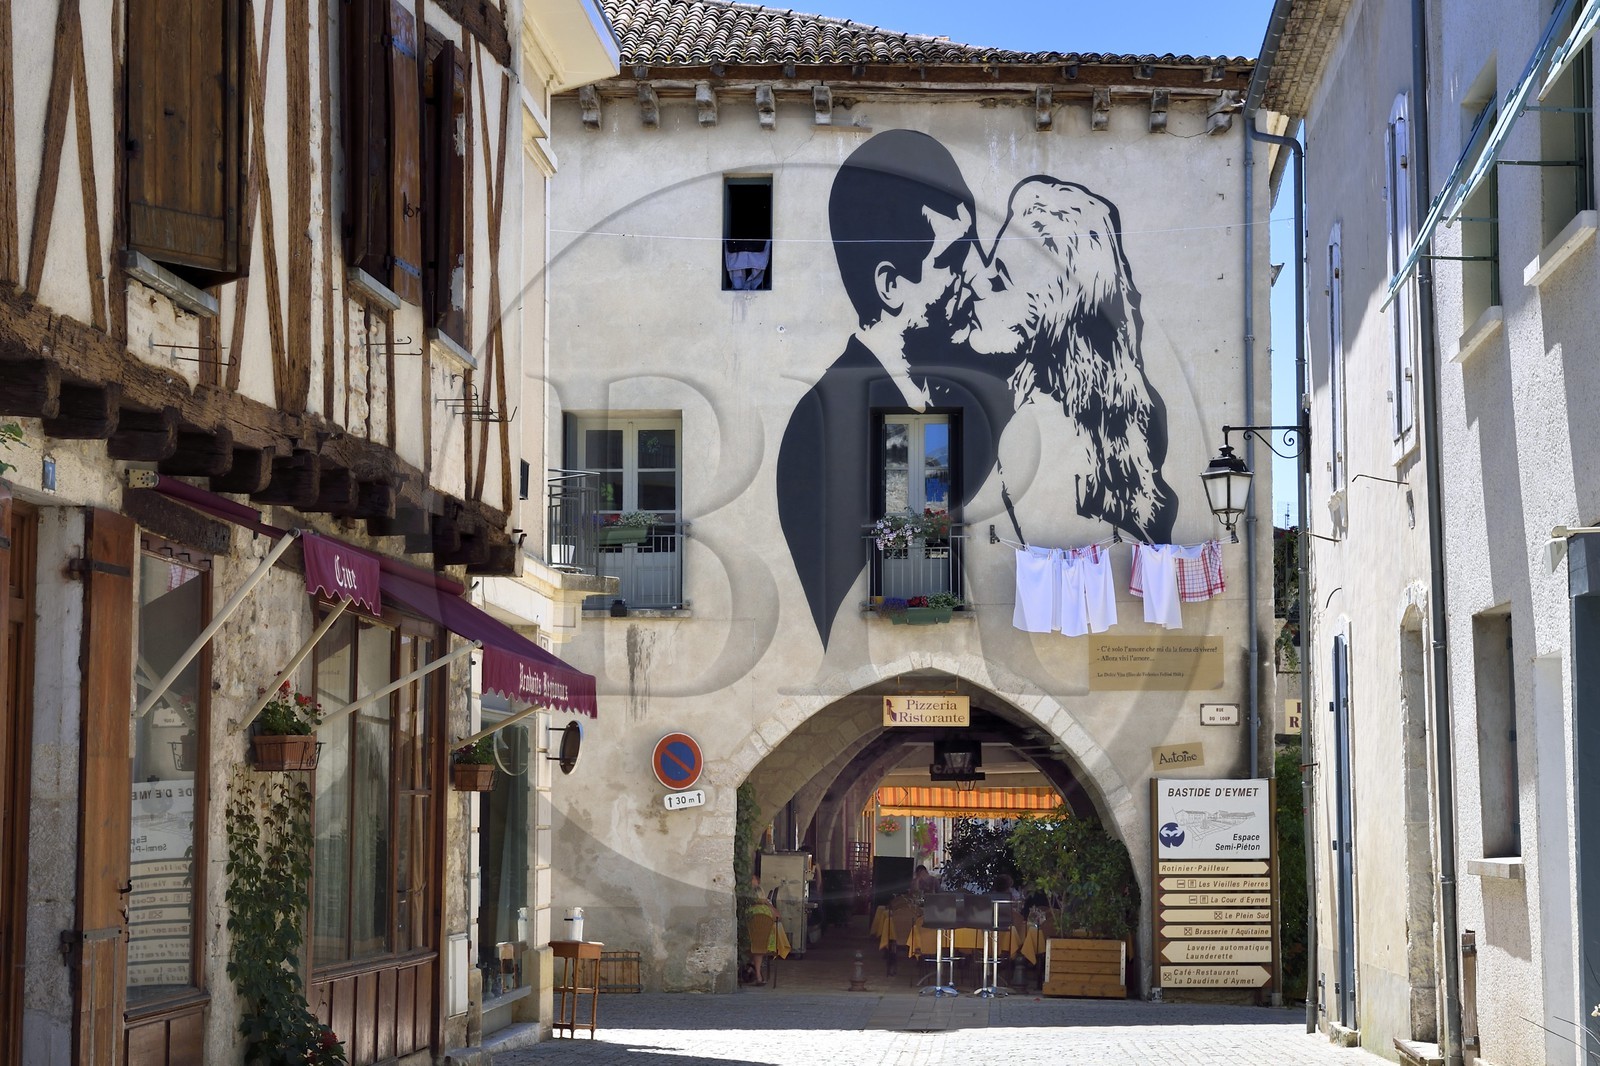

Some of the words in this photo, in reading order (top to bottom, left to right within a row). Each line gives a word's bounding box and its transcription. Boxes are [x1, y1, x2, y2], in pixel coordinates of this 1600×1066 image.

[906, 700, 957, 710] Pizzeria
[899, 712, 965, 722] Ristorante
[1168, 788, 1211, 797] BASTIDE
[1215, 788, 1259, 797] D'EYMET
[676, 796, 686, 805] 30
[1233, 834, 1260, 842] Espace
